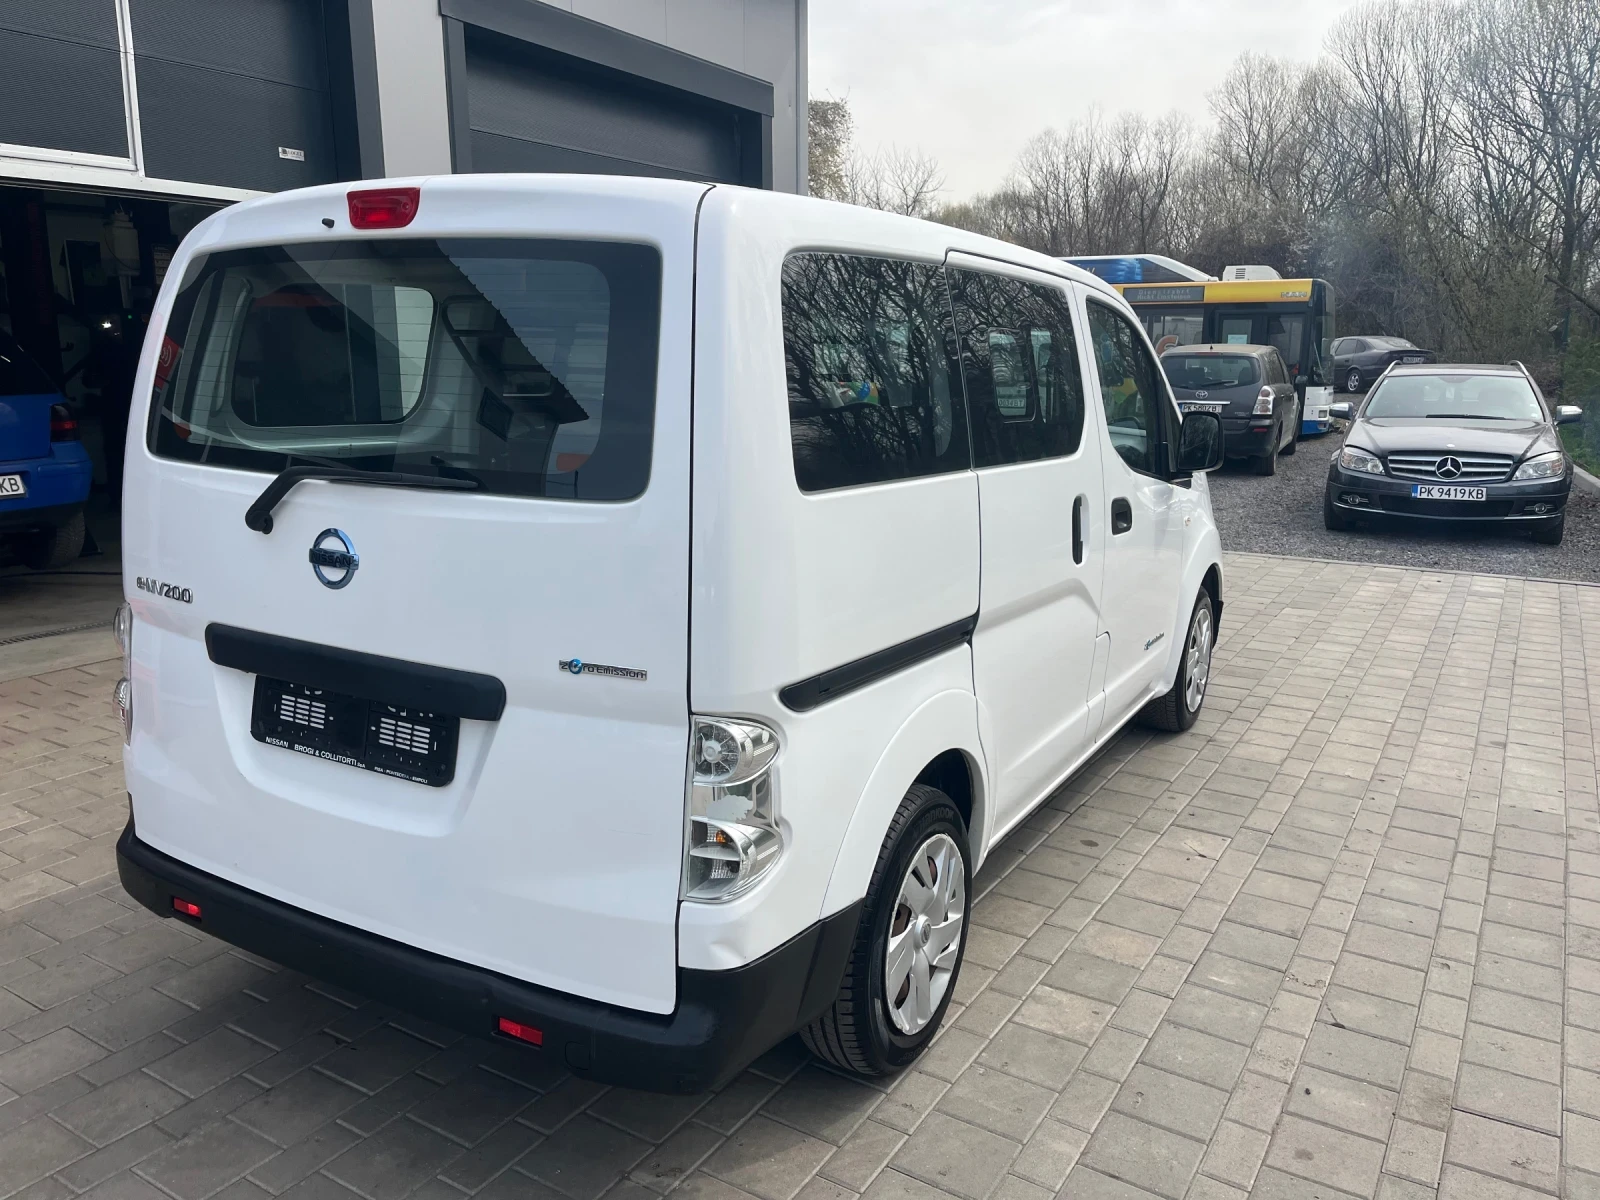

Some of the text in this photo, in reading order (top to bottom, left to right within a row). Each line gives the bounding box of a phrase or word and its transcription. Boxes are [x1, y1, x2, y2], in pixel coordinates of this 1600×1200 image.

[1419, 486, 1435, 498] PK
[310, 550, 354, 567] NISSAN
[265, 736, 289, 748] NISSAN
[294, 743, 314, 755] BROGI
[314, 749, 320, 757] &
[320, 750, 357, 766] COLLITORTI
